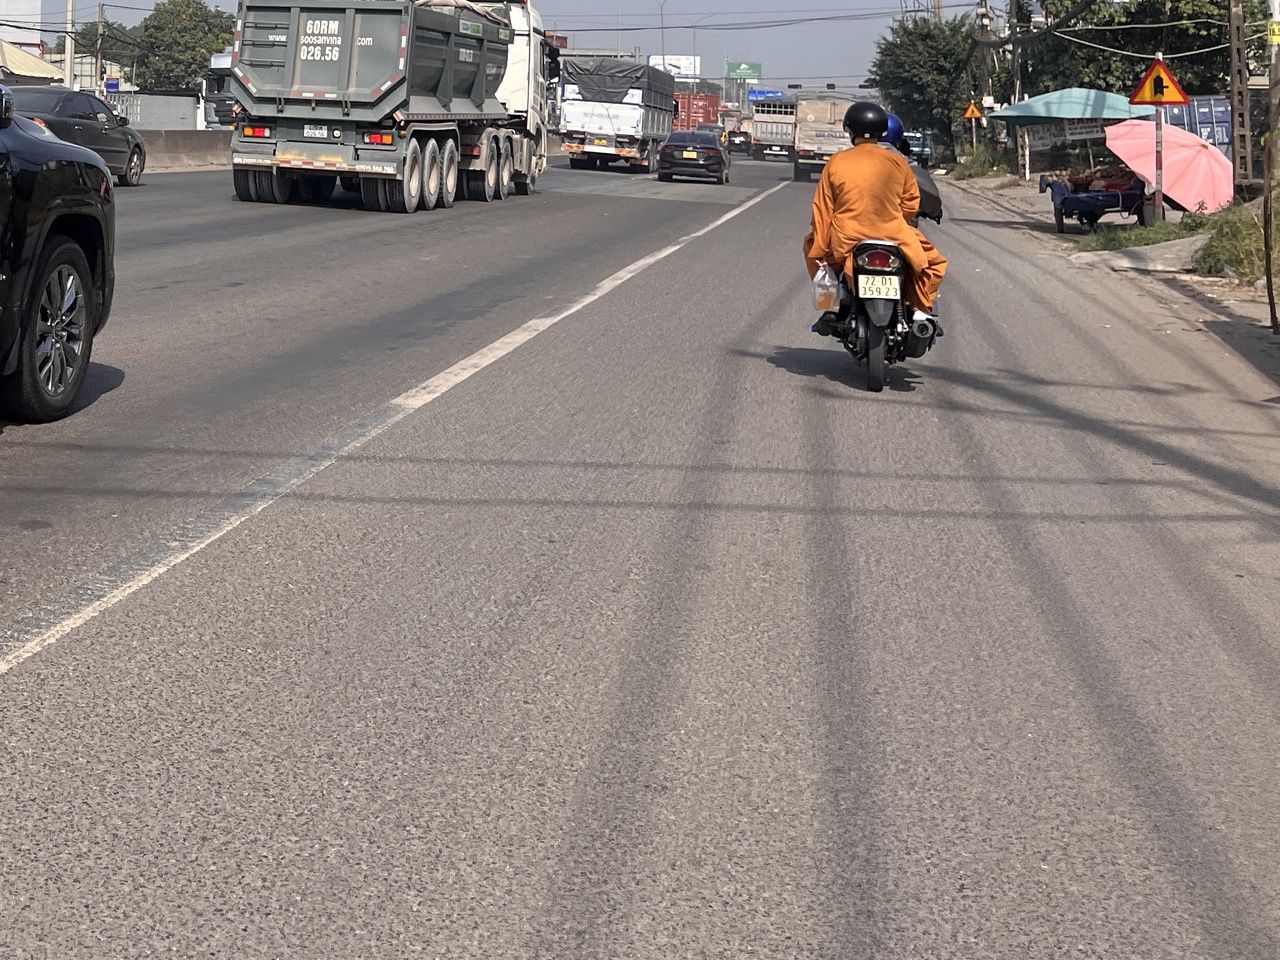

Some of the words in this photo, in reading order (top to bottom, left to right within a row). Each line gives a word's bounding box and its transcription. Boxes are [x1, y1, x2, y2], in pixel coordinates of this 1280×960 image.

[306, 20, 339, 35] 60RM
[300, 36, 342, 45] soosanvina
[300, 46, 340, 61] 026.56
